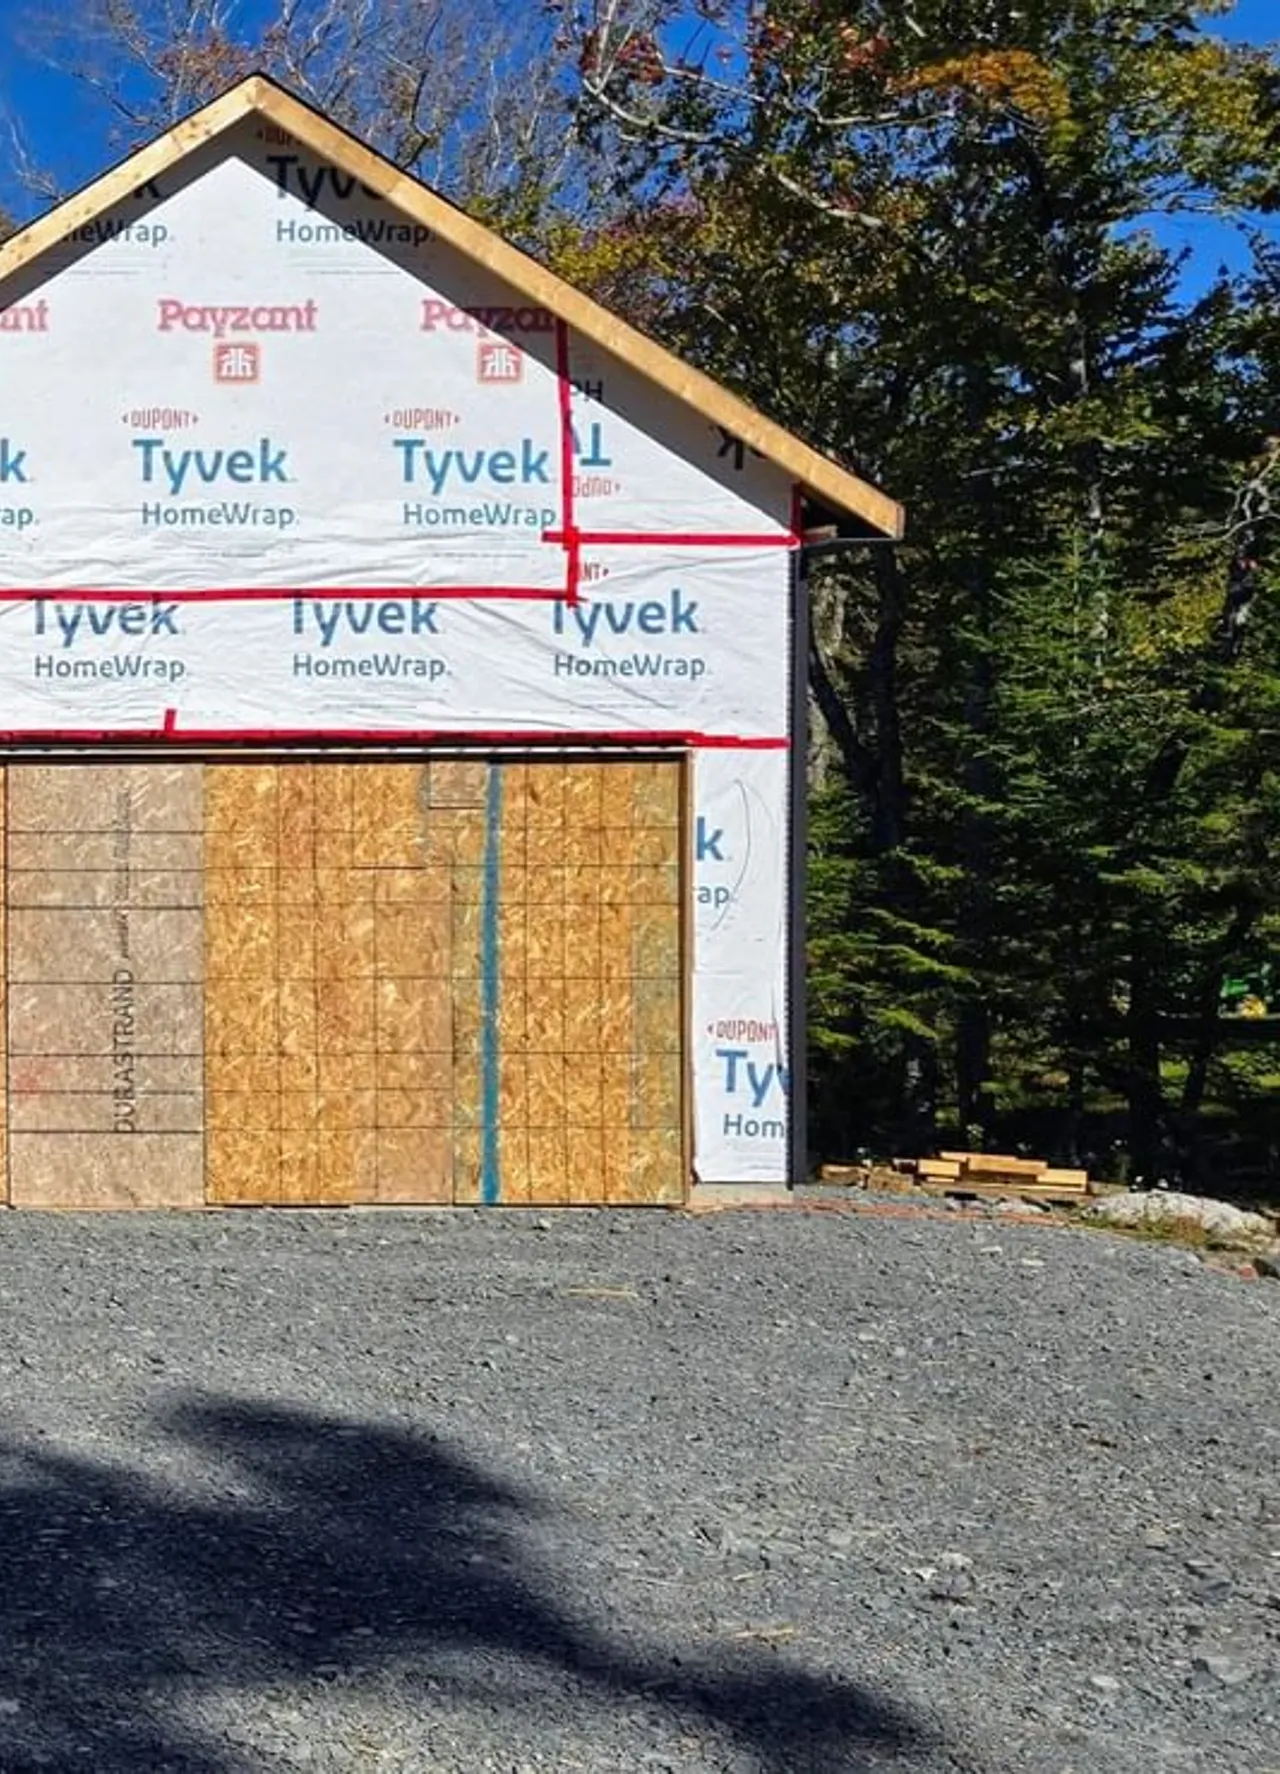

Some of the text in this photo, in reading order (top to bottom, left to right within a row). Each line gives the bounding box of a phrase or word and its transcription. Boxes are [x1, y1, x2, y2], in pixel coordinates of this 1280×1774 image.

[267, 156, 382, 212] Tyv
[277, 221, 428, 247] HomeWrap
[157, 300, 318, 337] Payzant
[420, 300, 555, 337] Payza
[132, 437, 290, 495] Tyvek
[393, 438, 550, 495] Tyvek
[142, 503, 294, 526] HomeWrap
[403, 503, 556, 527] HomeWrap
[33, 594, 179, 648] Tyvek
[293, 597, 438, 647] Tyvek
[553, 589, 699, 647] Tyvek
[35, 656, 185, 682] HomeWrap
[292, 655, 446, 681] HomeWrap
[554, 655, 705, 681] HomeWrap
[113, 969, 137, 1134] DURASTRAND
[716, 1051, 790, 1108] Tyv
